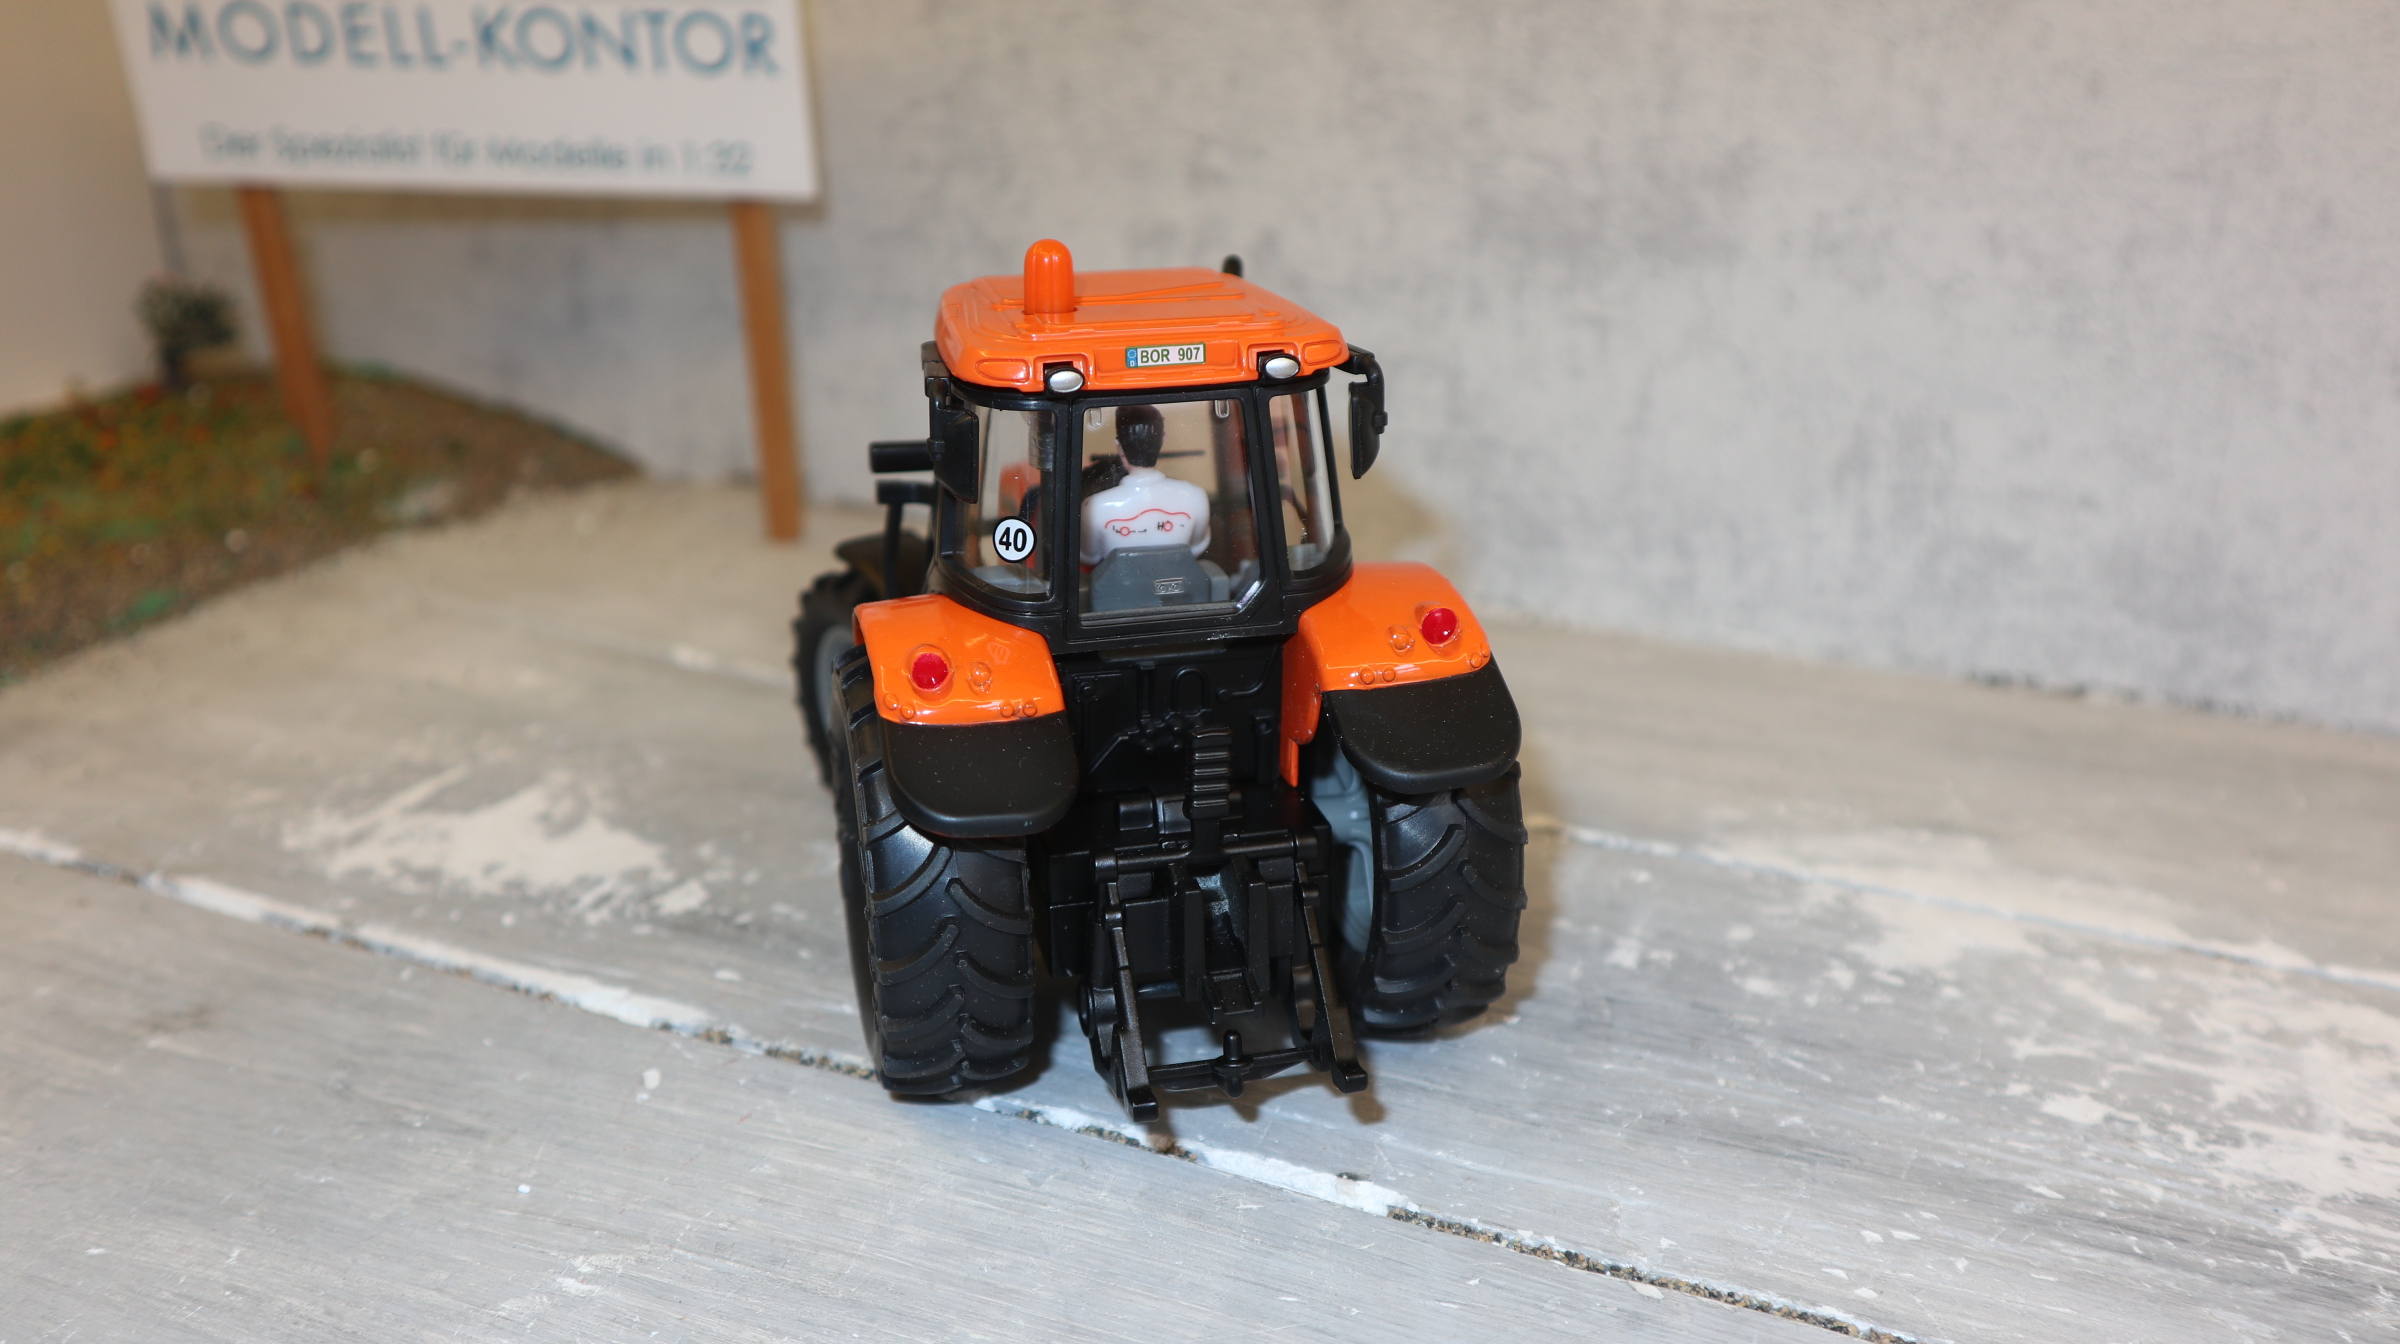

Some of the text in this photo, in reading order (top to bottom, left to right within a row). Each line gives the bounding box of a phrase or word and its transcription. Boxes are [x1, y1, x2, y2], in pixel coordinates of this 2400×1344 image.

[149, 0, 780, 76] MODELL-KONTOR
[1140, 347, 1200, 363] BOR 907
[999, 526, 1028, 552] 40
